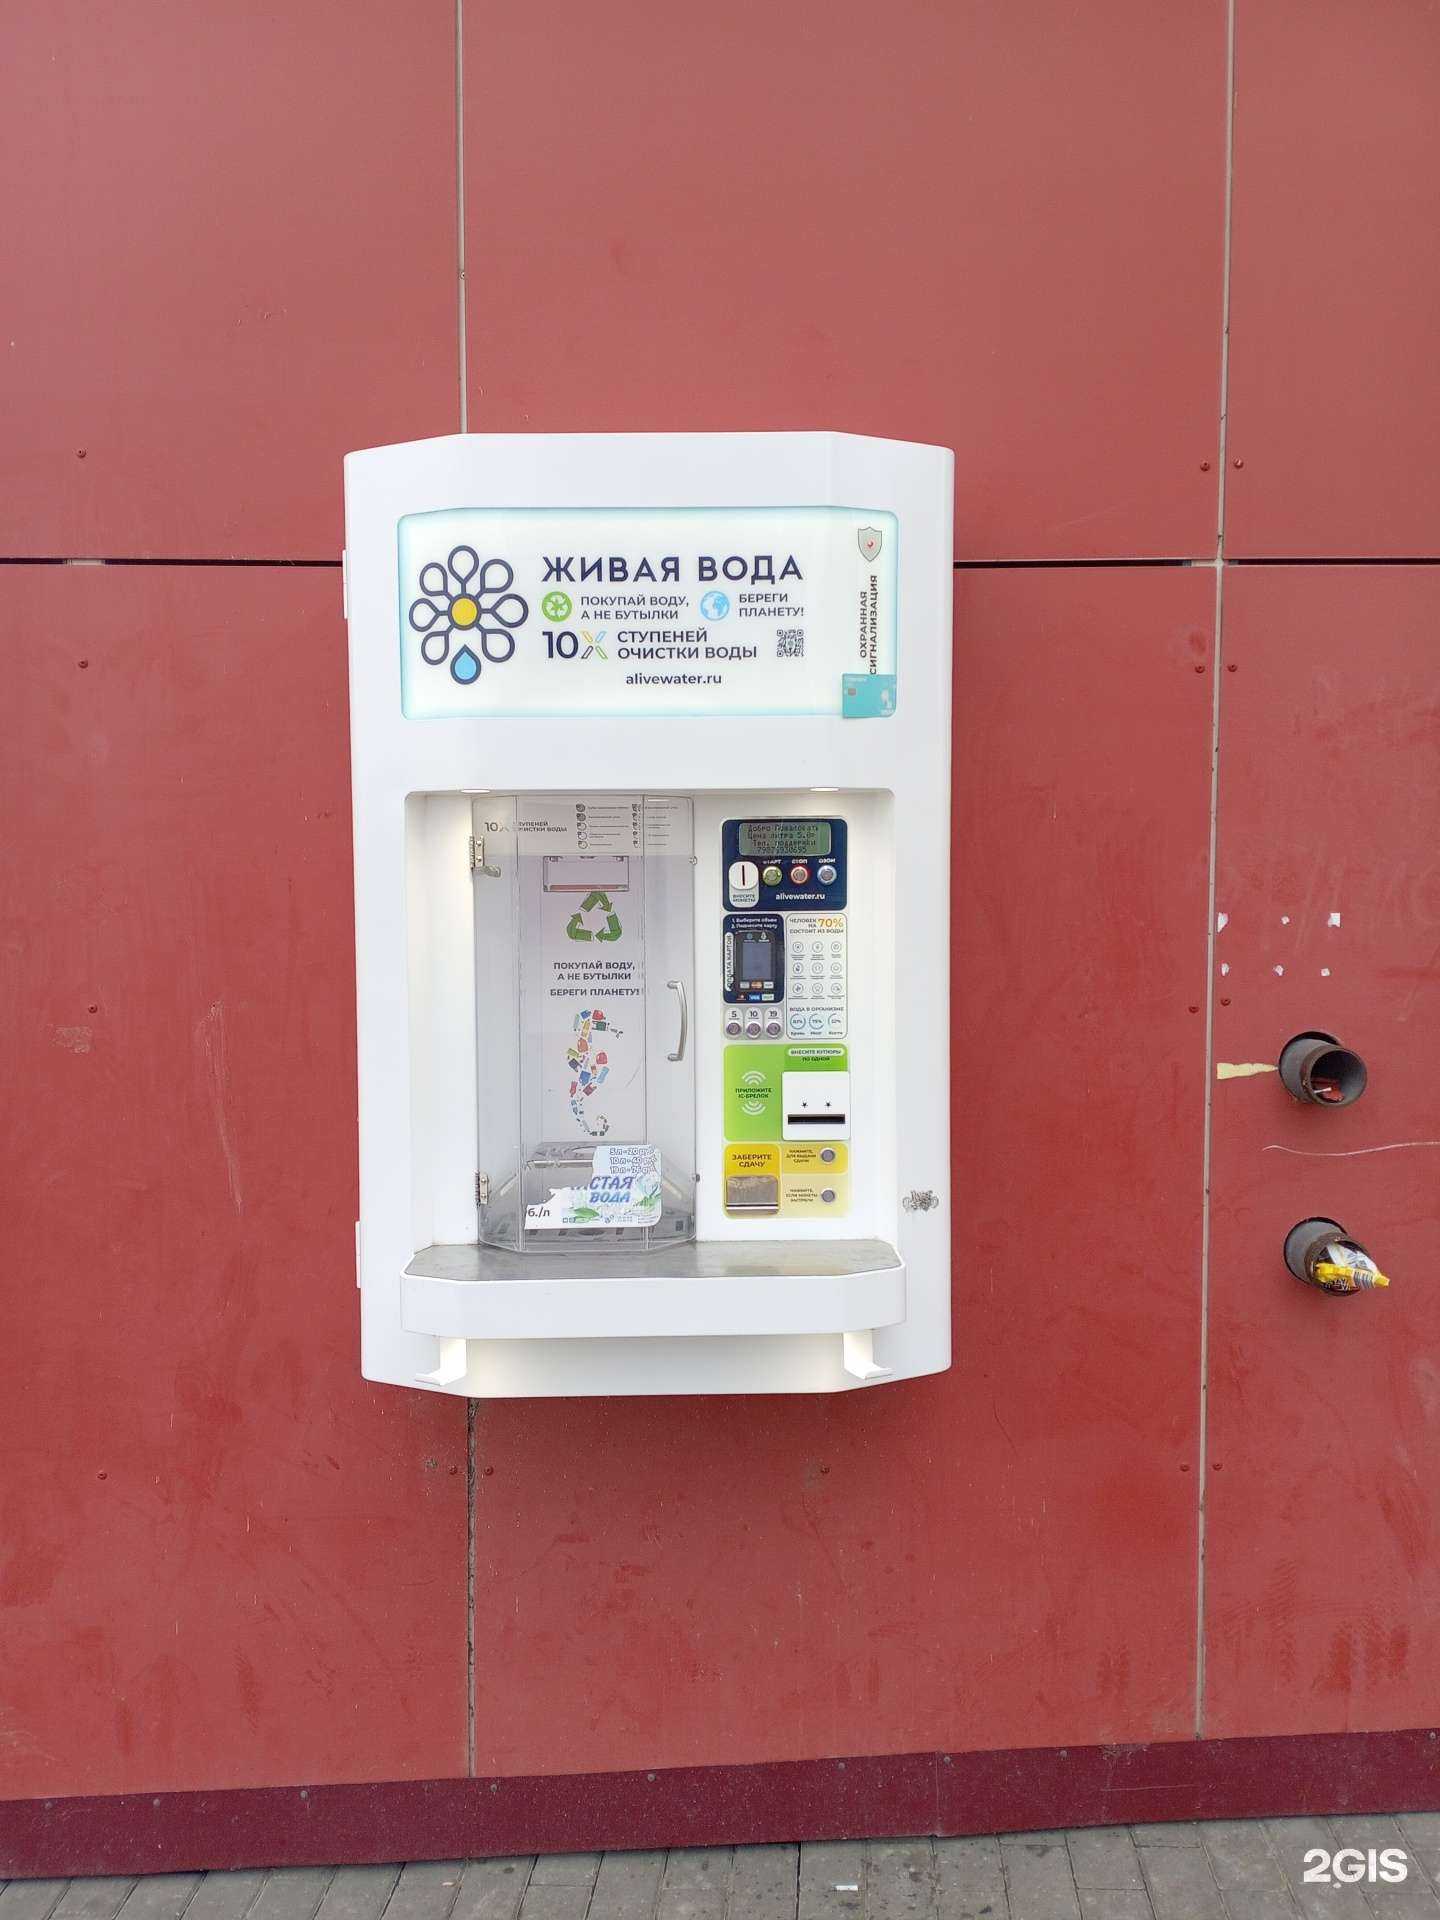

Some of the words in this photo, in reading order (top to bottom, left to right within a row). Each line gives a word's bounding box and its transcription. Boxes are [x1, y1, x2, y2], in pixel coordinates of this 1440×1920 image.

[541, 556, 680, 583] ЖИВАЯ
[698, 554, 804, 586] ВОДА
[580, 593, 646, 606] ПОКУПАЙ
[649, 595, 690, 608] ВОДУ,
[739, 592, 789, 603] БЕРЕГИ
[580, 610, 590, 620] А
[593, 610, 612, 620] НЕ
[615, 609, 679, 620] БУТЫЛКИ
[739, 606, 805, 617] ПЛАНЕТУ!
[859, 591, 868, 658] ОХРАННАЯ
[869, 575, 879, 675] СИГНАЛИЗАЦИЯ
[617, 626, 708, 644] СТУПЕНЕЙ
[617, 646, 699, 660] ОЧИСТКИ
[704, 645, 758, 661] ВОДЫ
[625, 672, 723, 686] alivewater.ru
[775, 893, 826, 901] alivewater.ru
[817, 917, 844, 928] 70%
[553, 960, 603, 970] ПОКУПАЙ
[605, 962, 635, 971] ВОДУ,
[557, 973, 565, 981] А
[567, 973, 581, 981] НЕ
[583, 973, 632, 981] БУТЫЛКИ
[550, 988, 588, 997] БЕРЕГИ
[590, 988, 640, 997] ПЛАНЕТУ!
[750, 1010, 759, 1018] 10
[732, 1153, 773, 1161] ЗАБЕРИТЕ
[738, 1161, 766, 1169] СДАЧУ
[589, 1191, 631, 1203] ВОДА
